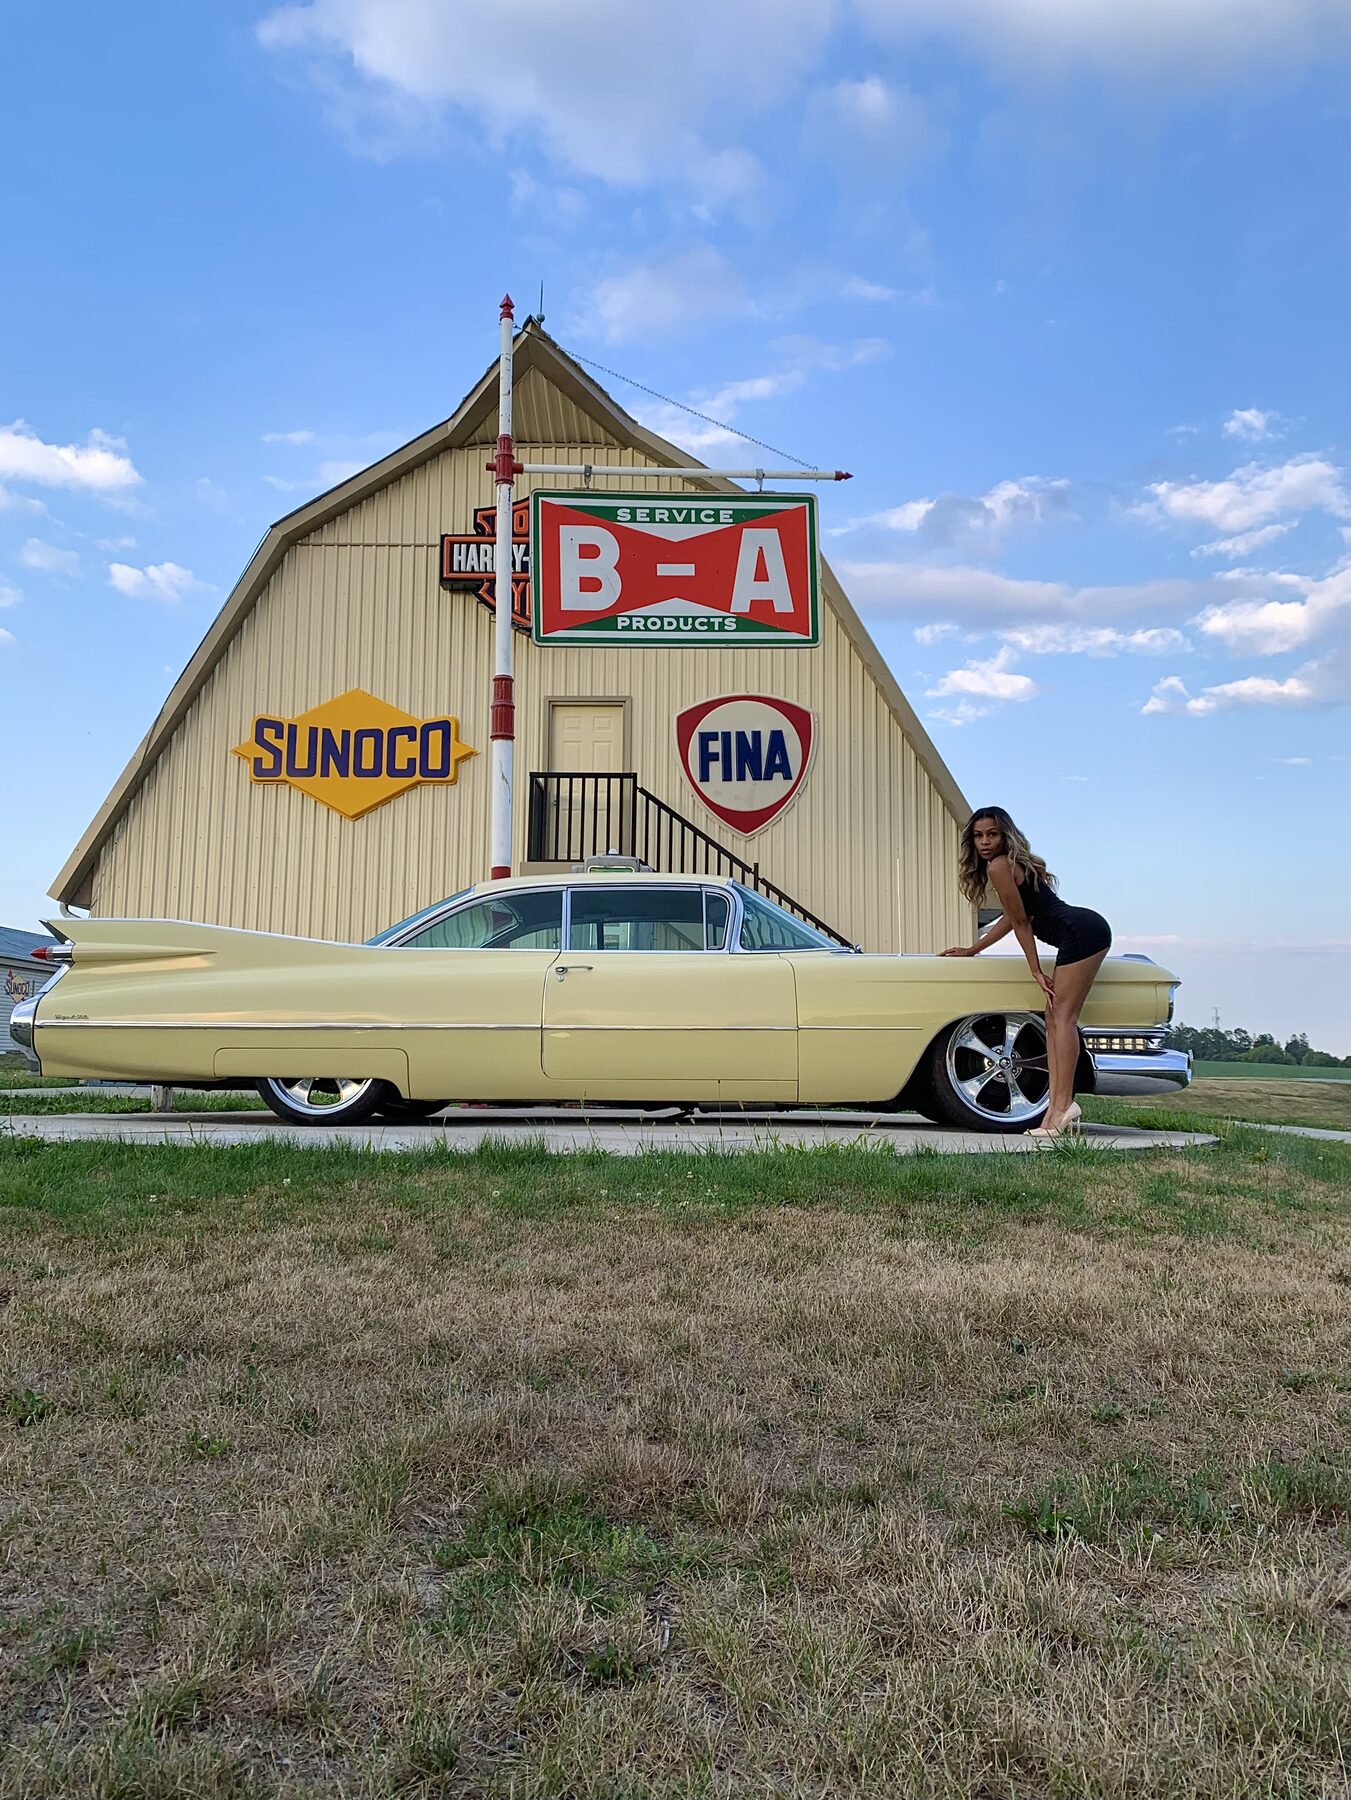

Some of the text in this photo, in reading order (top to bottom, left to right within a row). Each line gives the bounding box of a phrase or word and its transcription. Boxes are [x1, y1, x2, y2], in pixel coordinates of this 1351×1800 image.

[616, 508, 734, 522] SERVICE
[617, 617, 737, 631] PRODUCTS
[253, 718, 451, 778] SUNOCO
[698, 730, 793, 782] FINA
